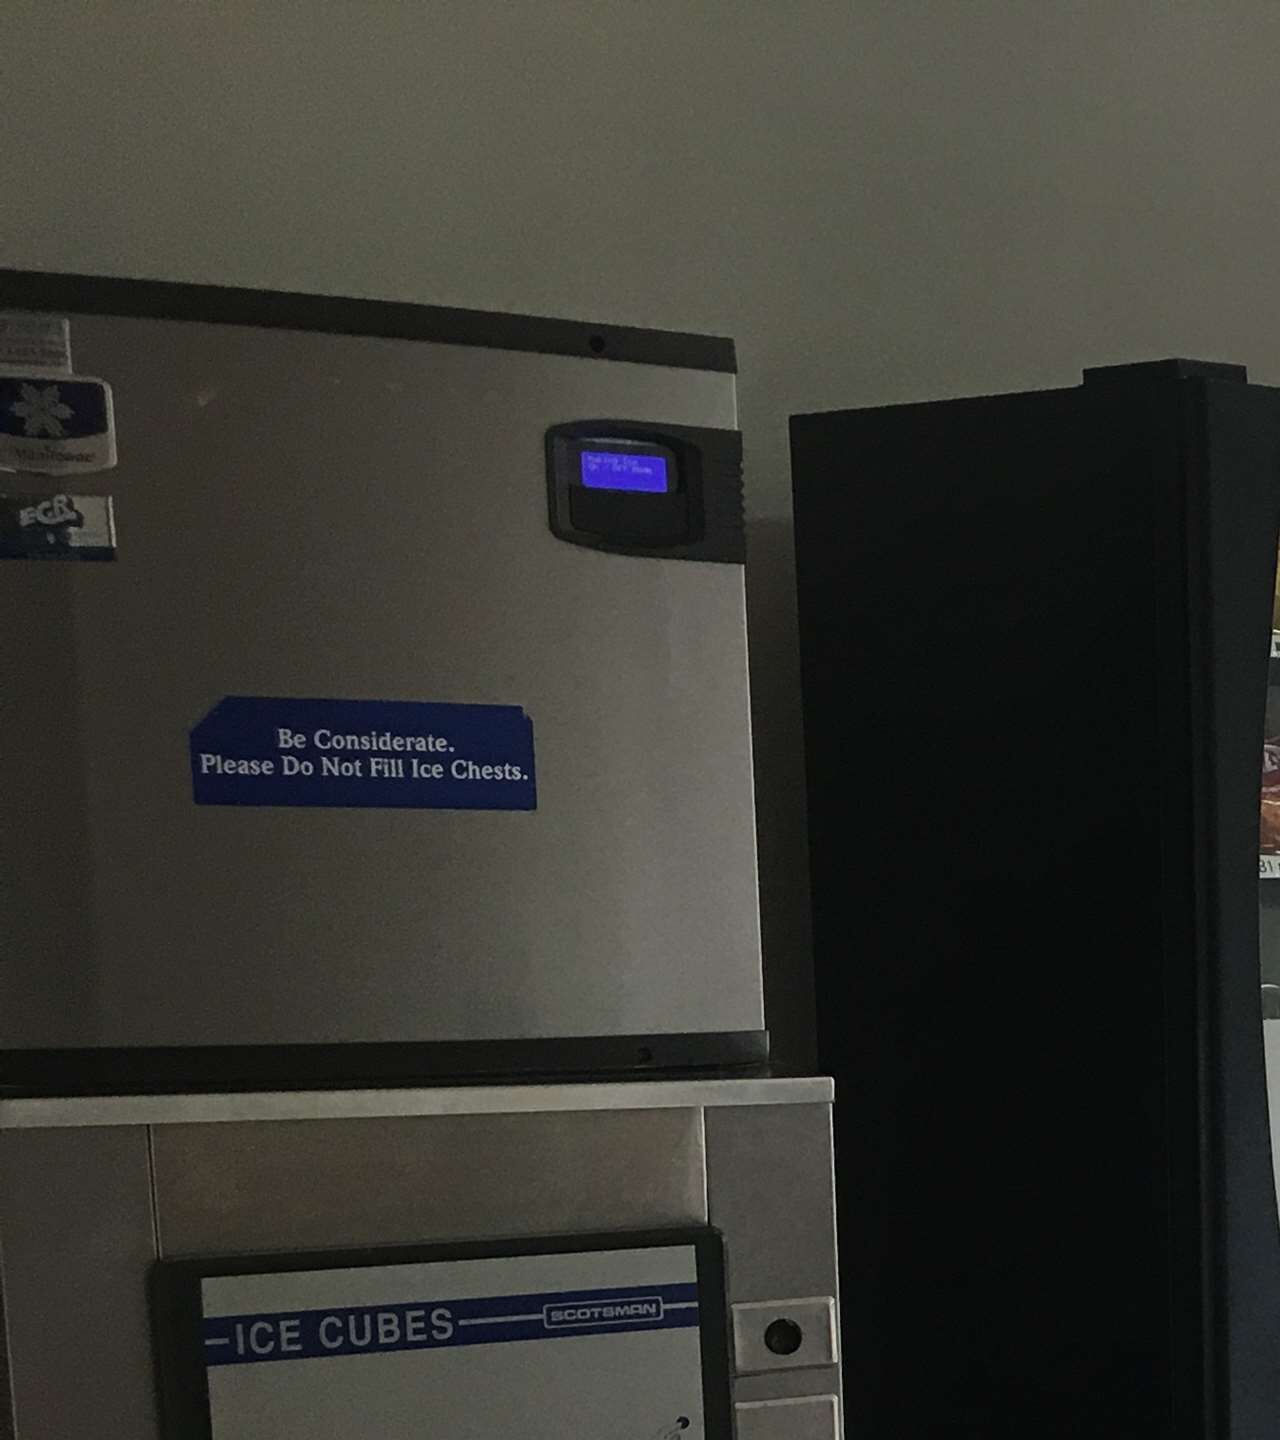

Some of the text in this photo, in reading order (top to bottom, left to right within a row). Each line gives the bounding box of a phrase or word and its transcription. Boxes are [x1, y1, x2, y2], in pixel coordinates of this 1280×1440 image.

[278, 728, 455, 752] Be Considerate.
[200, 754, 530, 782] Please Do Not Fill Ice Chests.
[1259, 860, 1273, 873] B1
[550, 1302, 657, 1322] SCOTSMAN
[235, 1309, 456, 1356] ICE CUBES
